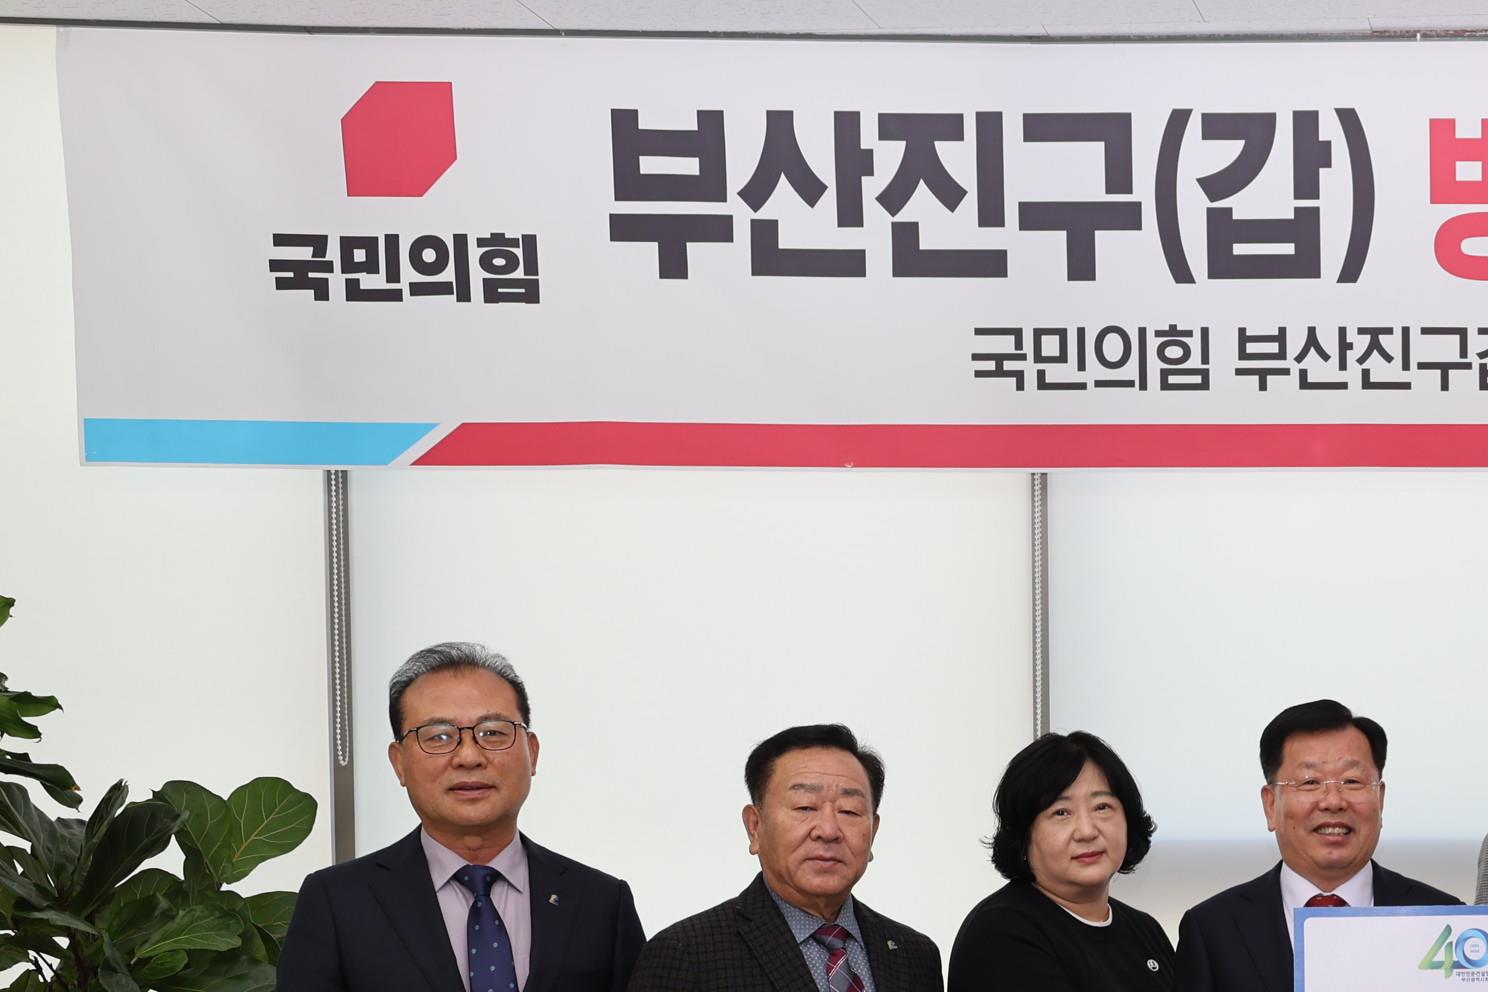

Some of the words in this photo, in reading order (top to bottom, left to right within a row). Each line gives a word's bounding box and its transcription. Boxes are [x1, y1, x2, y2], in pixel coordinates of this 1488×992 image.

[609, 107, 1375, 285] 부산진구(갑)
[268, 232, 541, 305] 국민의힘
[971, 323, 1210, 392] 국민의힘
